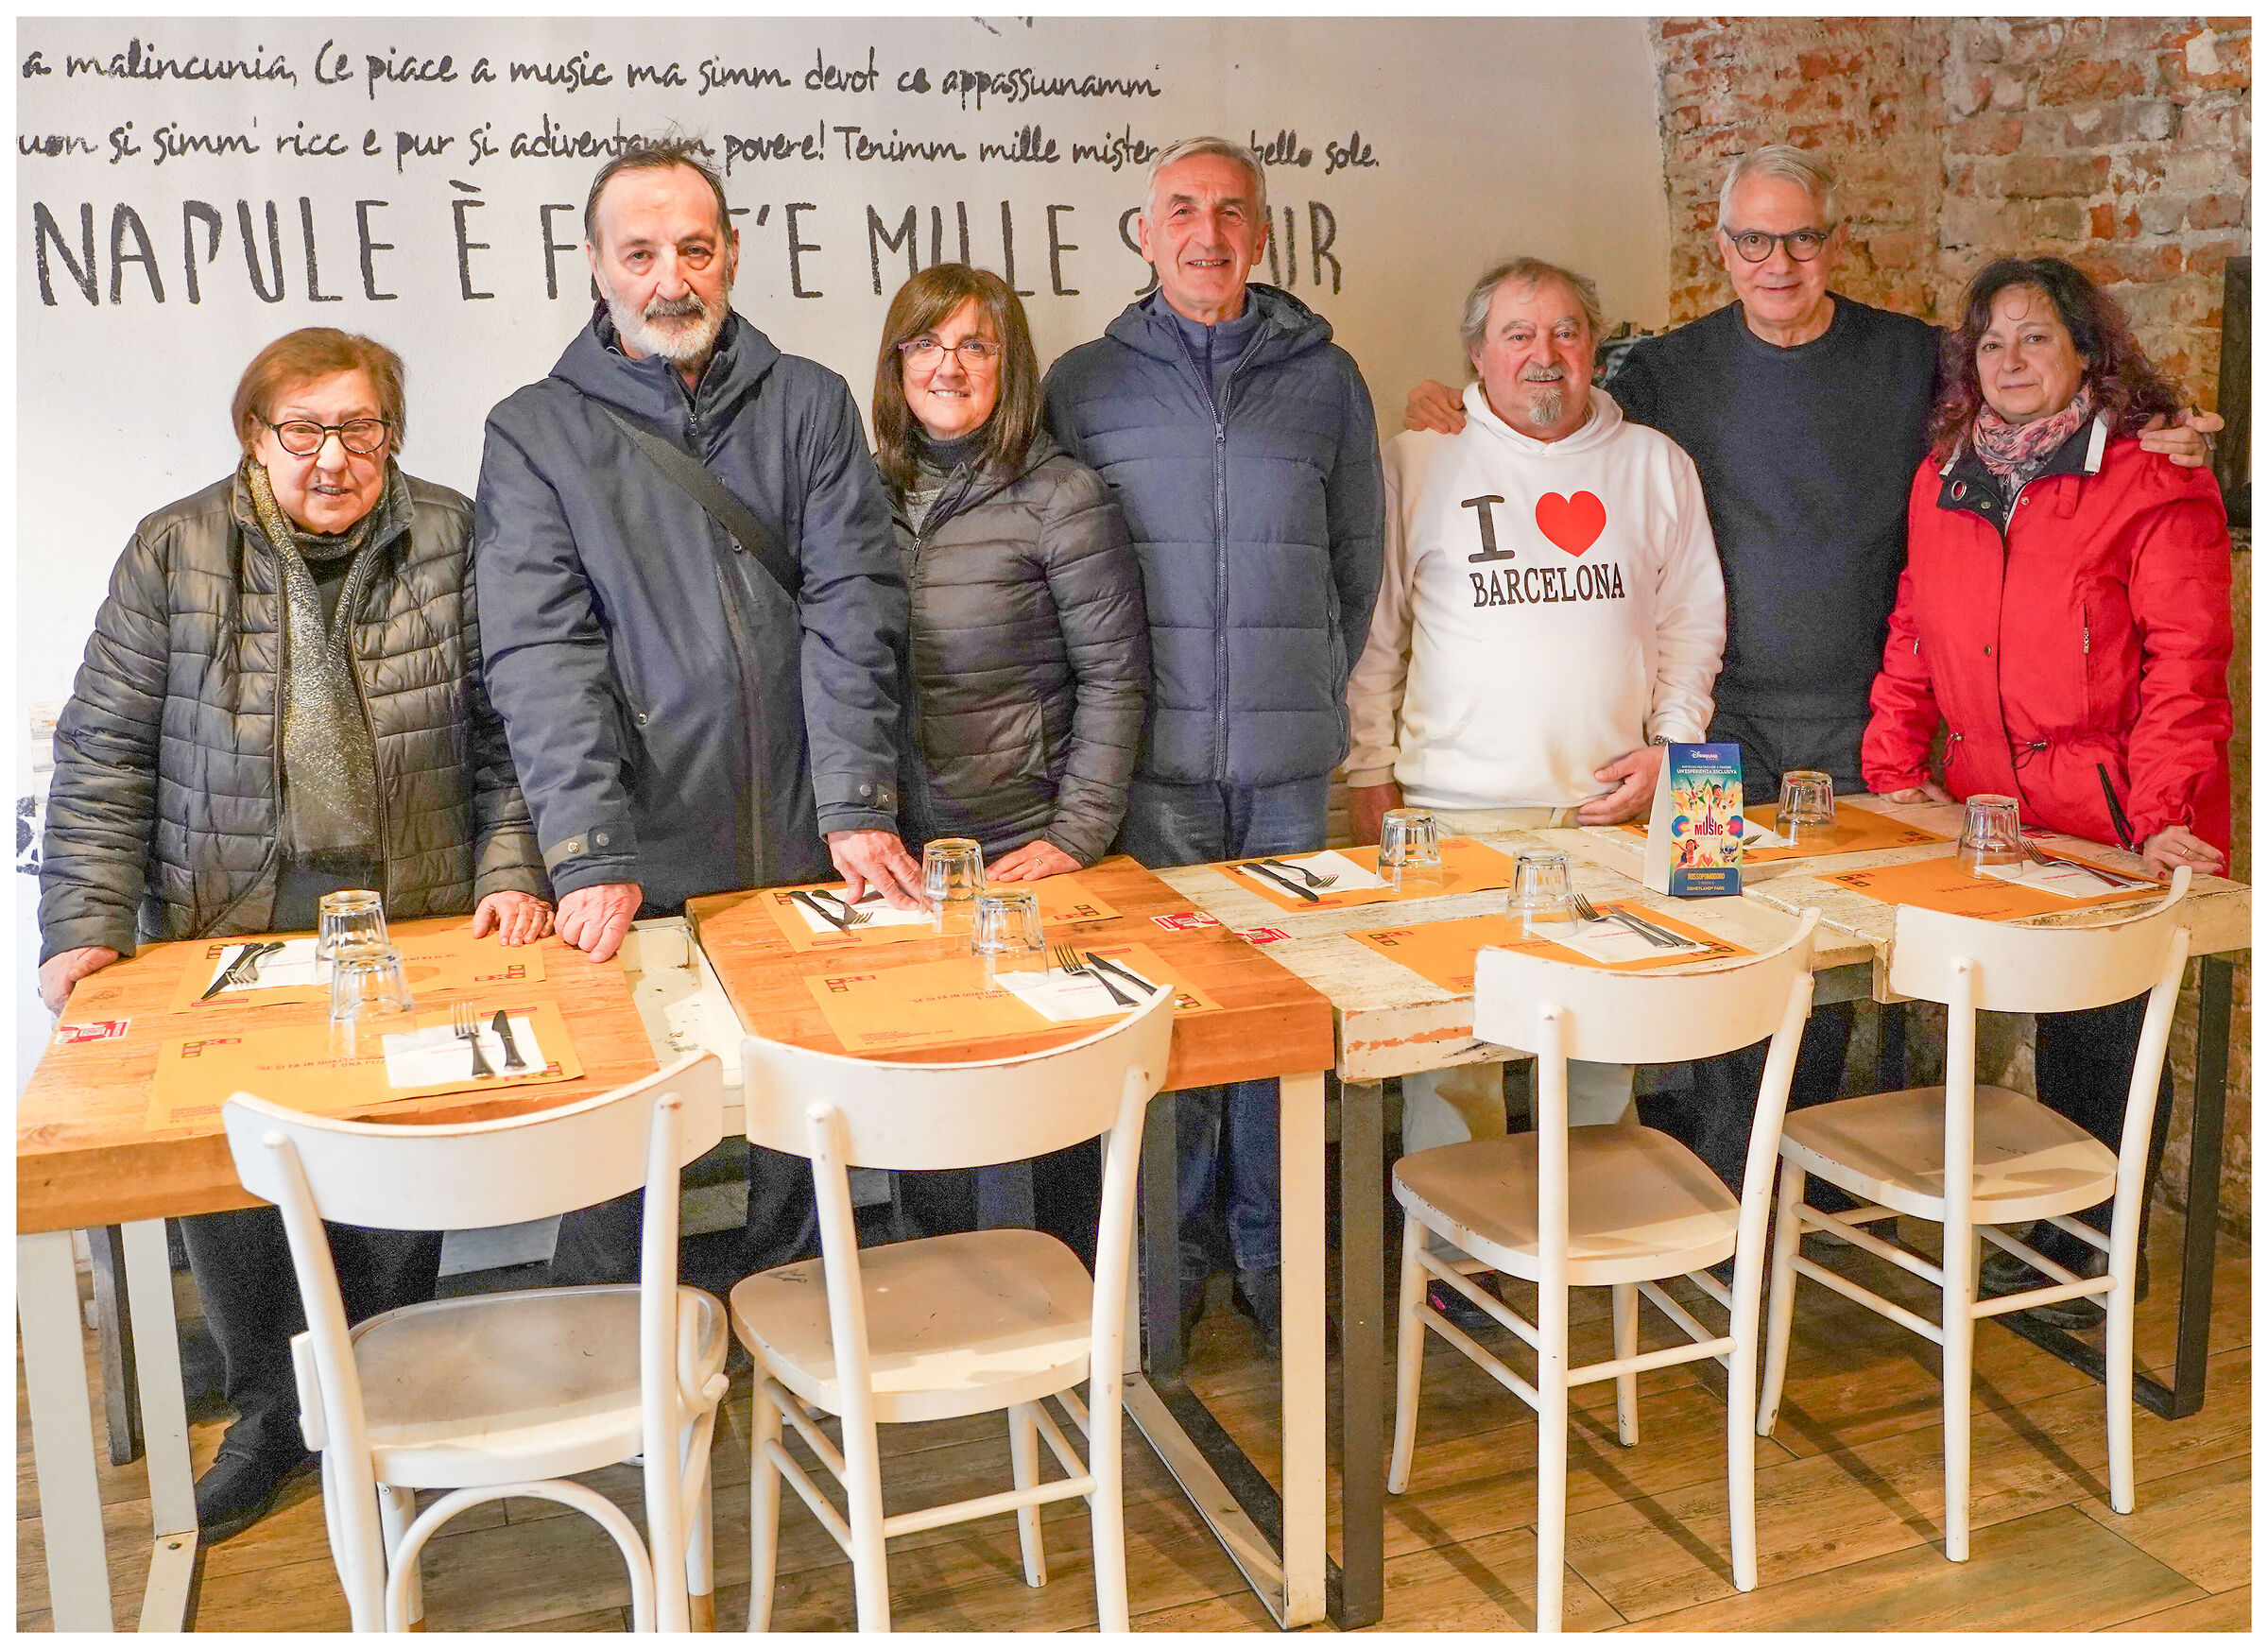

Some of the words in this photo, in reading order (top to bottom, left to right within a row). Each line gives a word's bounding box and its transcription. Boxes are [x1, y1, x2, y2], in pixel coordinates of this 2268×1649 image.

[66, 37, 297, 90] malincunia,
[366, 45, 458, 100] piace
[471, 58, 496, 84] a
[509, 50, 613, 94] music
[627, 62, 687, 88] ma
[697, 54, 792, 96] simm
[804, 45, 879, 93] devot
[109, 120, 141, 165] si
[277, 119, 349, 157] ricc
[363, 129, 382, 157] e
[396, 130, 455, 174] pur
[469, 121, 499, 166] si
[723, 119, 825, 177] povere!
[833, 126, 967, 162] Tenimm
[979, 124, 1061, 163] mille
[1325, 130, 1380, 175] sole.
[33, 197, 401, 306] NAPULE
[448, 180, 494, 302] È
[1461, 494, 1516, 564] I
[1469, 561, 1625, 608] BARCELONA
